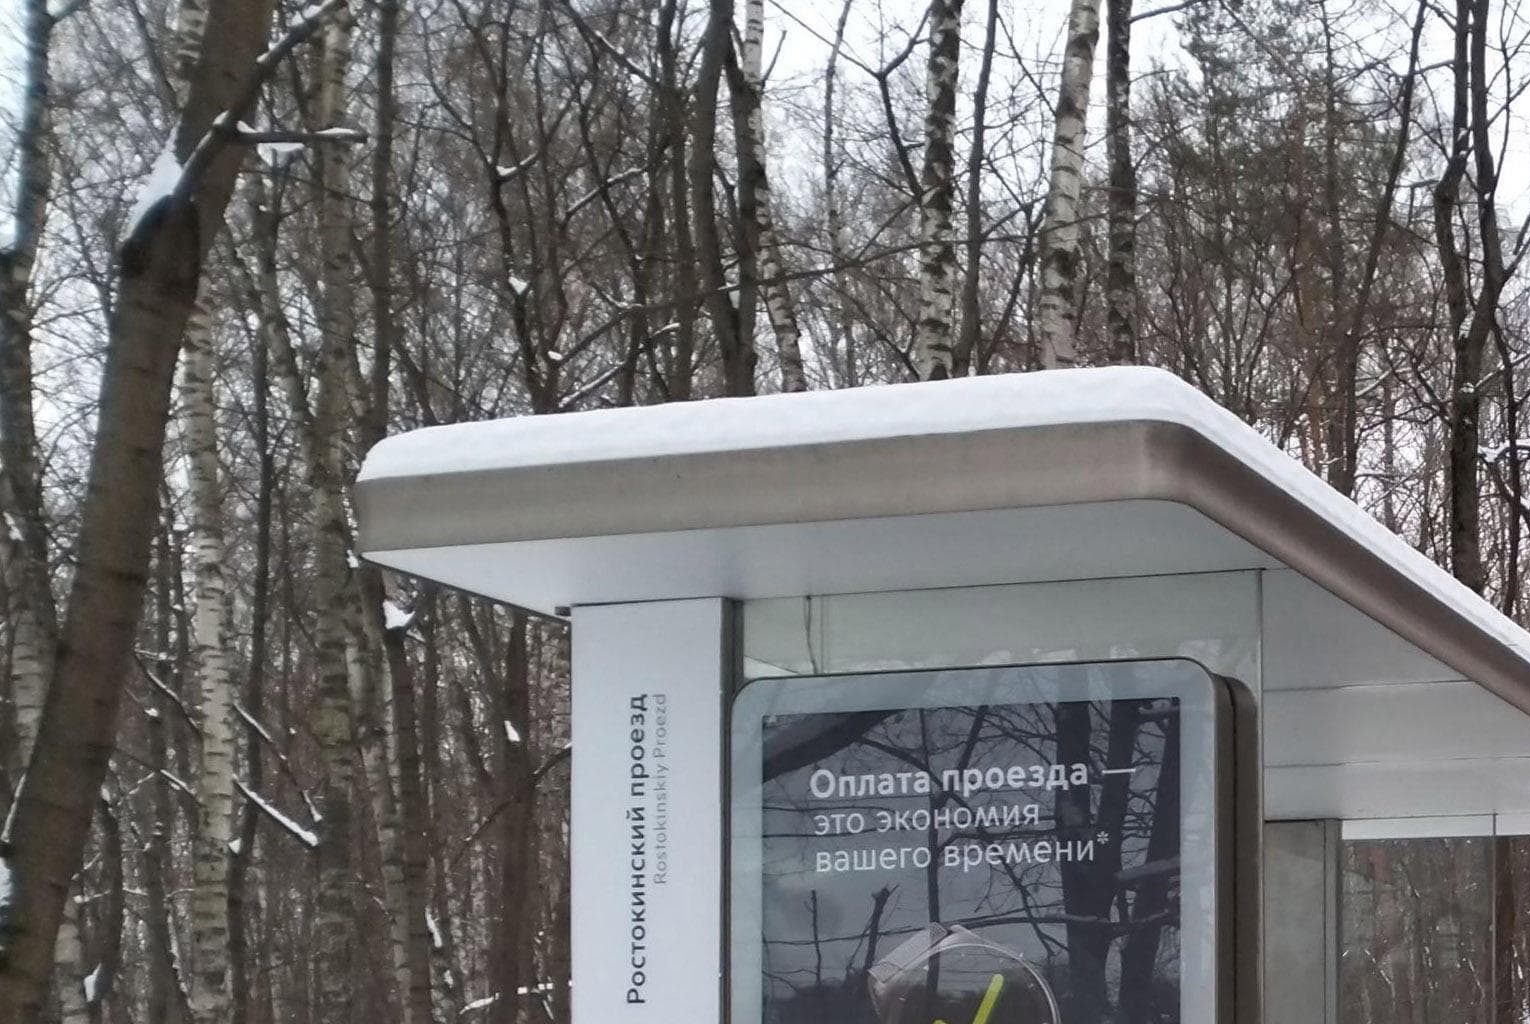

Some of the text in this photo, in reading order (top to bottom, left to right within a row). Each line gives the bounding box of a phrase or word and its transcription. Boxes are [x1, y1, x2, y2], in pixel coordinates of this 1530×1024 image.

[652, 693, 669, 885] Rostokinskiy Proezd
[809, 768, 931, 799] Оплата
[942, 762, 1089, 798] проезда
[813, 803, 1040, 836] это экономия
[625, 693, 650, 1005] Ростокинский проезд
[815, 845, 932, 873] вашего
